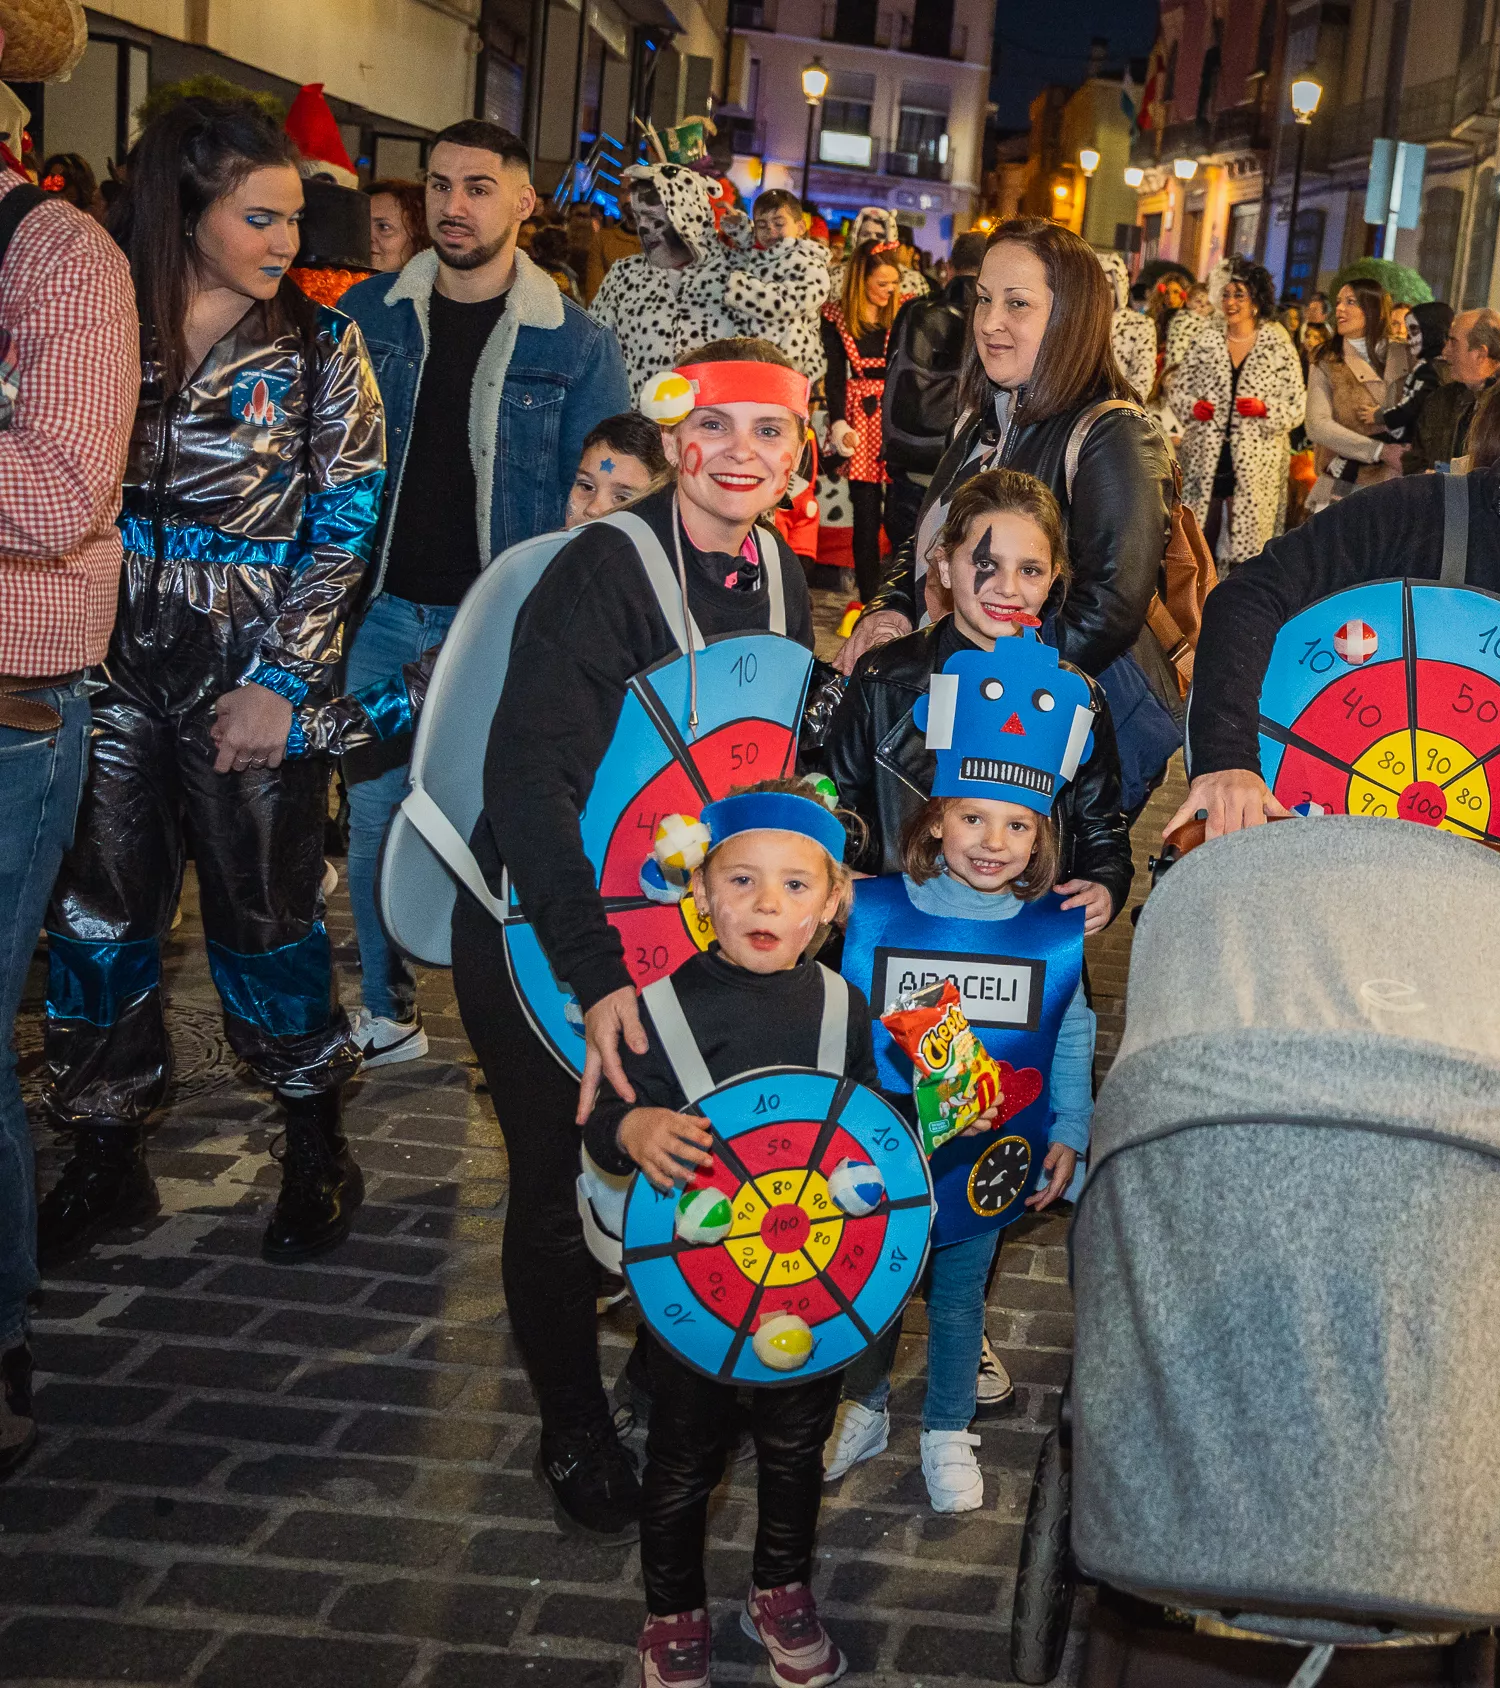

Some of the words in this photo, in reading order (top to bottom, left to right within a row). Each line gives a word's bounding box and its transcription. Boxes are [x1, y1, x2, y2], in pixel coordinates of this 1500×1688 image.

[1299, 638, 1335, 674] 10
[730, 652, 758, 686] 10
[1342, 688, 1382, 728] 40
[1452, 683, 1498, 723] 50
[730, 742, 758, 768] 50
[1377, 751, 1405, 775] 80
[1426, 748, 1452, 774] 90
[1361, 793, 1388, 818] 90
[1407, 792, 1443, 819] 100
[1456, 788, 1483, 810] 80
[636, 946, 669, 973] 30
[752, 1093, 780, 1114] 10
[767, 1138, 792, 1157] 50
[873, 1126, 899, 1152] 10
[772, 1180, 792, 1196] 80
[737, 1201, 756, 1222] 90
[813, 1192, 828, 1210] 90
[767, 1215, 799, 1235] 100
[813, 1232, 831, 1246] 80
[742, 1246, 757, 1269] 80
[781, 1260, 801, 1273] 90
[664, 1302, 697, 1327] 10
